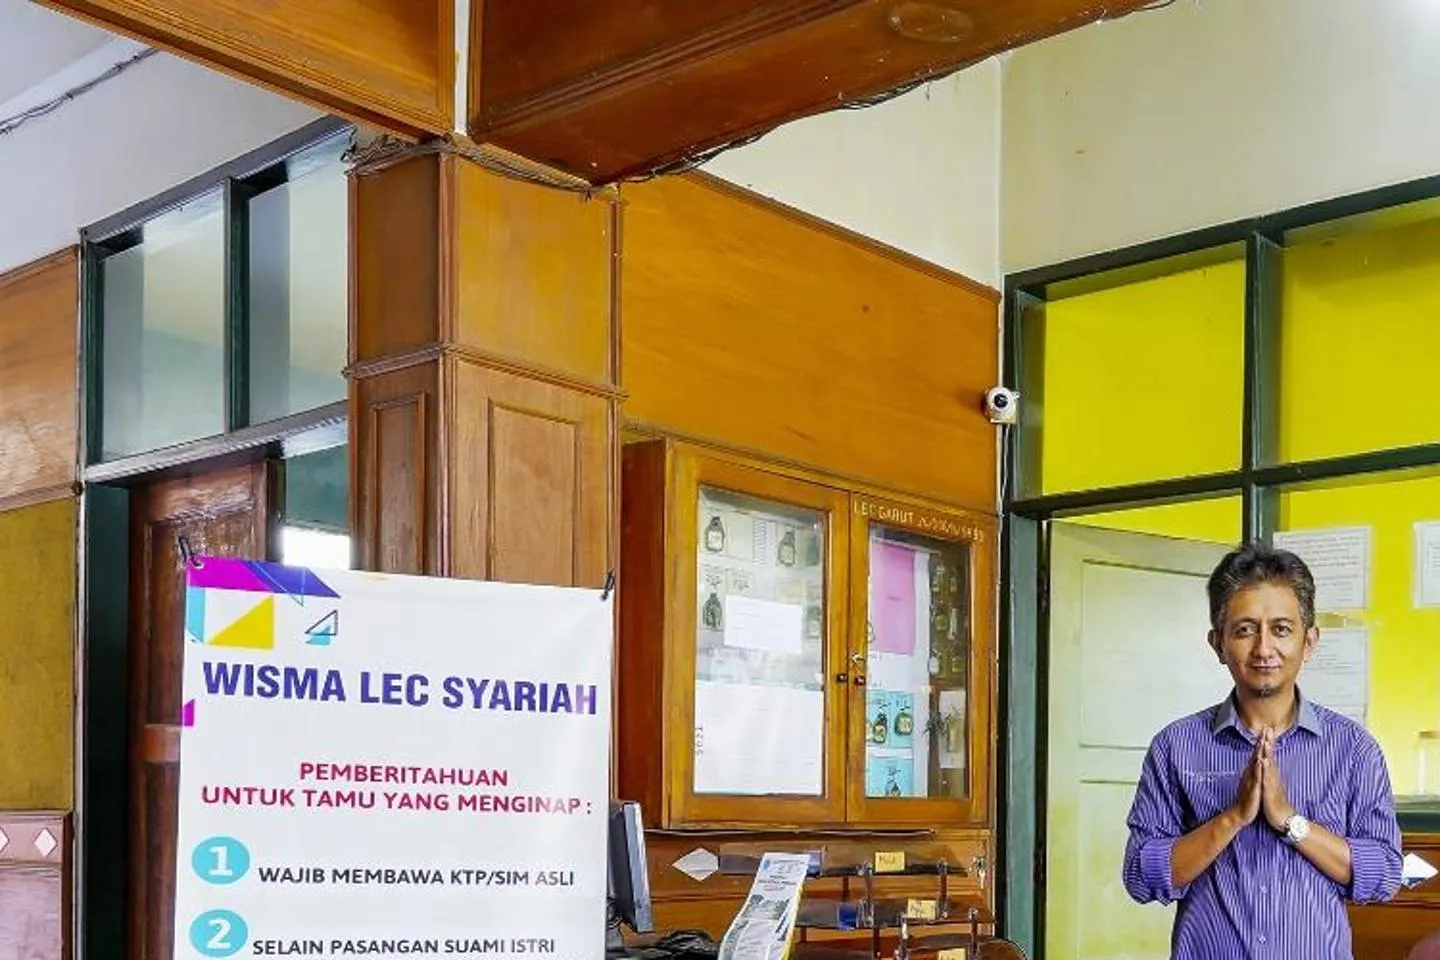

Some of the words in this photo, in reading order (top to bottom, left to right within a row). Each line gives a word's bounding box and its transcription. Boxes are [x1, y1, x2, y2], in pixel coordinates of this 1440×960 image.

[202, 662, 346, 702] WISMA
[360, 671, 430, 706] LEC
[442, 677, 597, 715] SYARIAH
[299, 762, 509, 786] PEMBERITAHUAN
[202, 786, 295, 807] UNTUK
[302, 790, 375, 809] TAMU
[383, 792, 449, 811] YANG
[457, 795, 581, 814] MENGINAP
[208, 846, 233, 877] 1
[258, 867, 325, 884] WAJIB
[331, 868, 445, 885] MEMBAWA
[450, 870, 530, 886] KTP/SIM
[535, 871, 575, 886] ASLI
[206, 918, 232, 949] 2
[252, 940, 324, 956] SELAIN
[330, 939, 439, 955] PASANGAN
[444, 939, 506, 954] SUAMI
[510, 938, 555, 953] ISTRI
